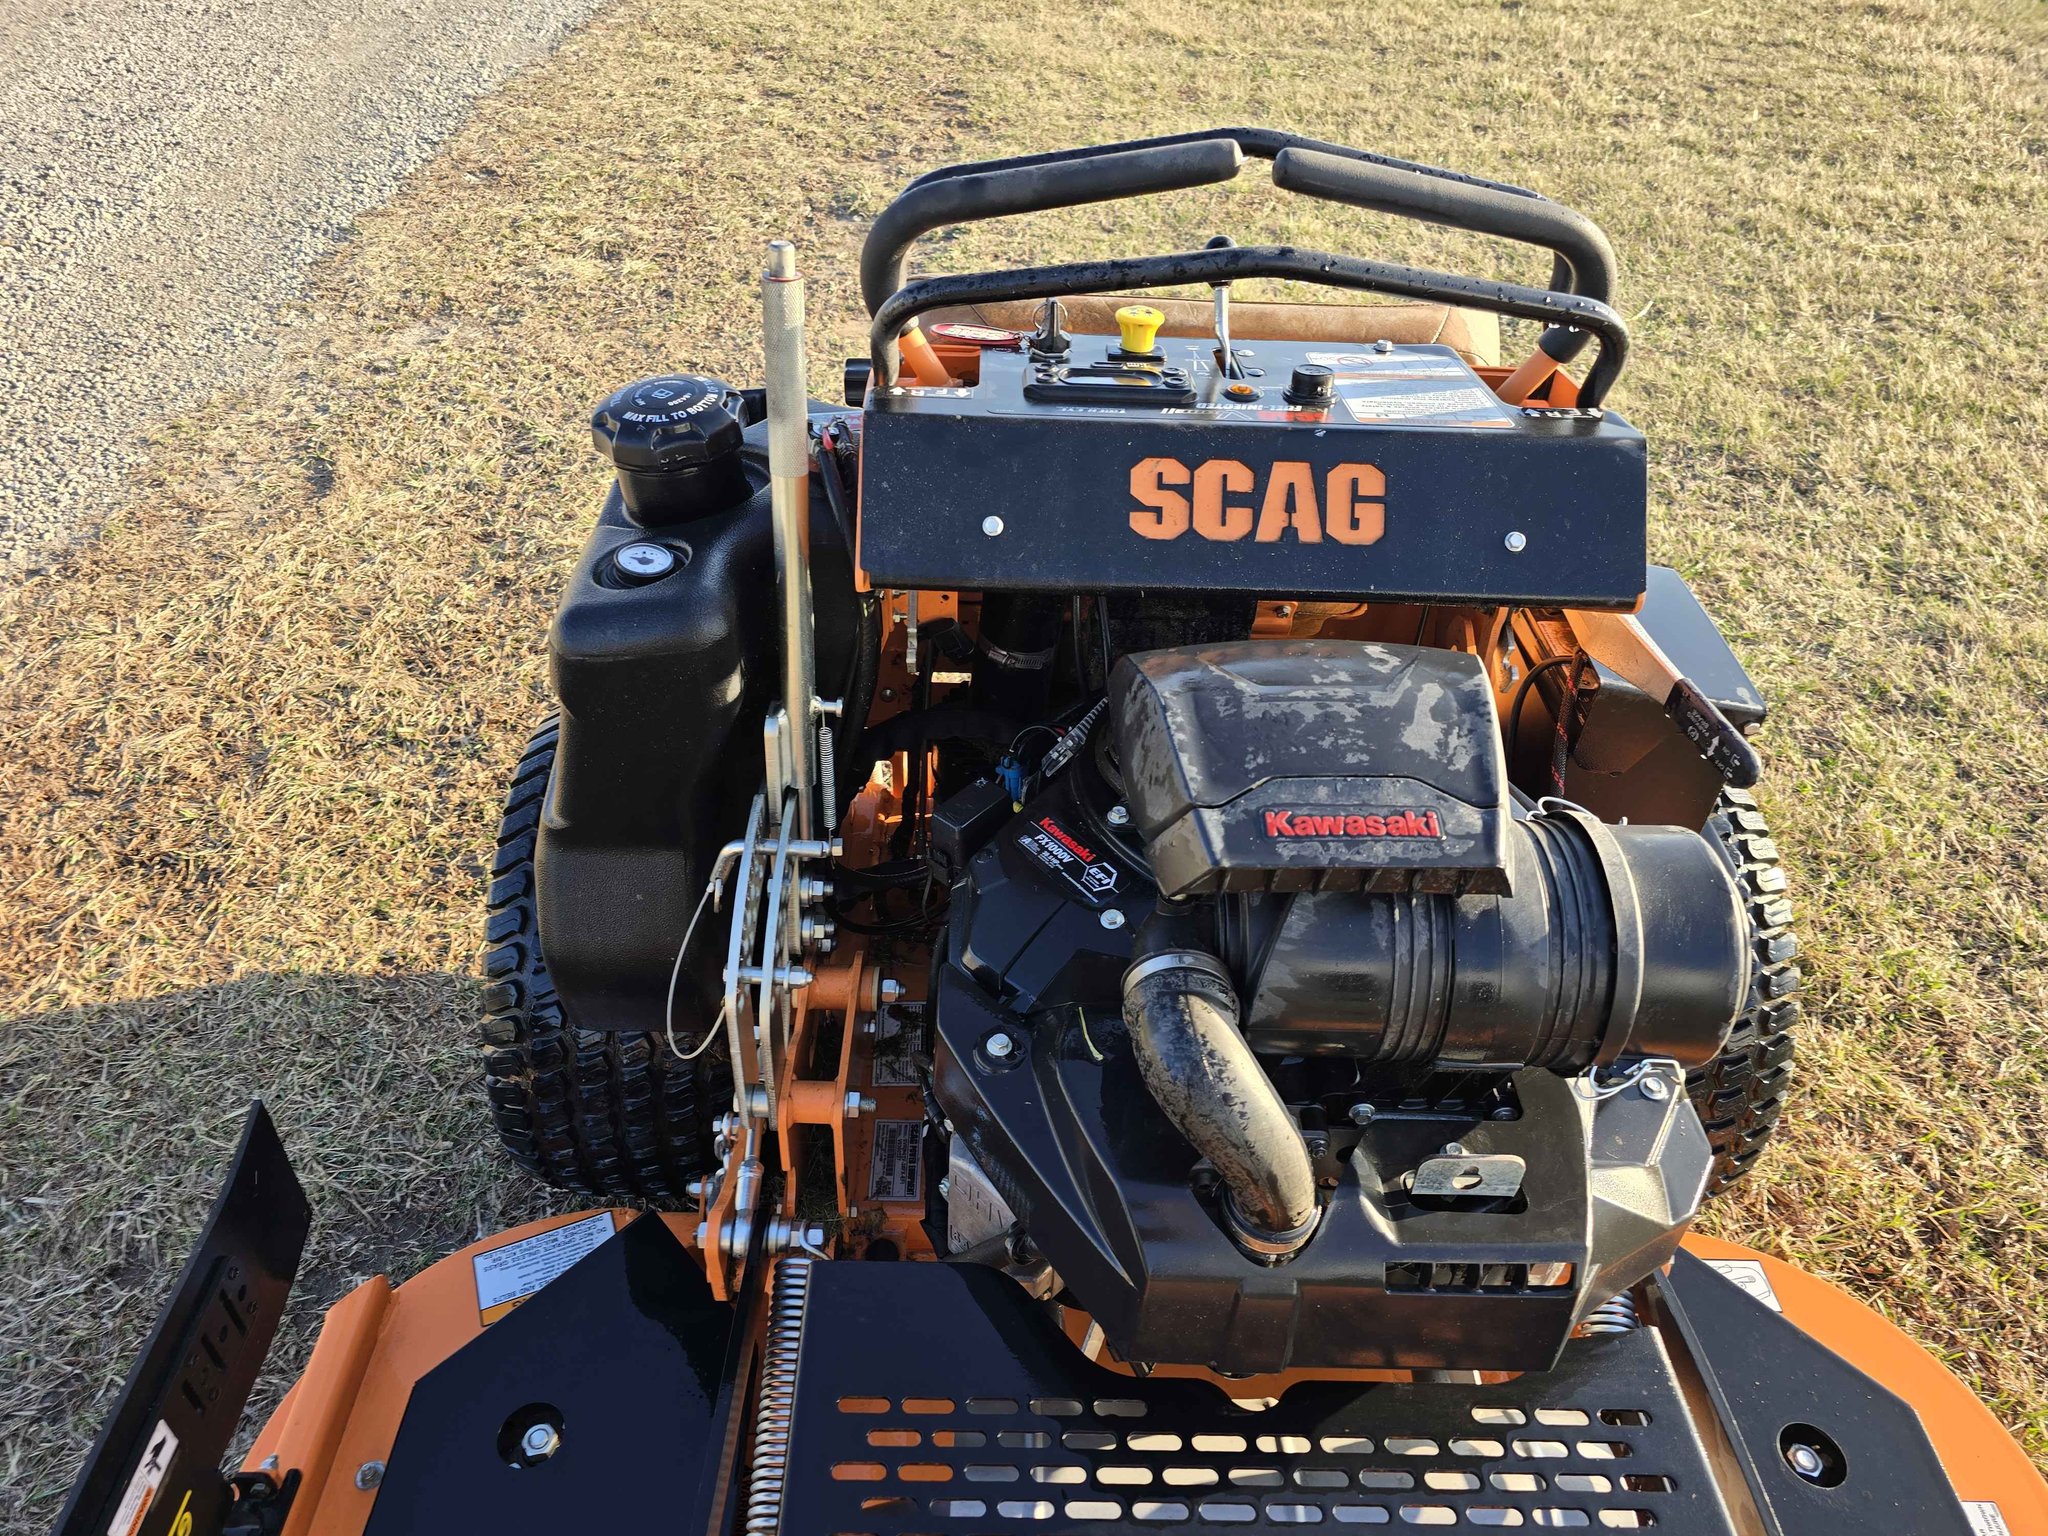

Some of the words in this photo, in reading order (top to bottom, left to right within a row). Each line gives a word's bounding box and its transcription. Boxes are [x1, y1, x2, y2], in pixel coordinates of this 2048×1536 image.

[622, 411, 646, 422] MAX
[645, 415, 670, 423] FILL
[670, 410, 688, 420] TO
[1129, 457, 1386, 546] SCAG
[1264, 810, 1441, 837] Kawasaki
[1034, 833, 1075, 864] FX1000V
[1039, 817, 1096, 863] Kawasaki
[1088, 867, 1112, 885] EFI
